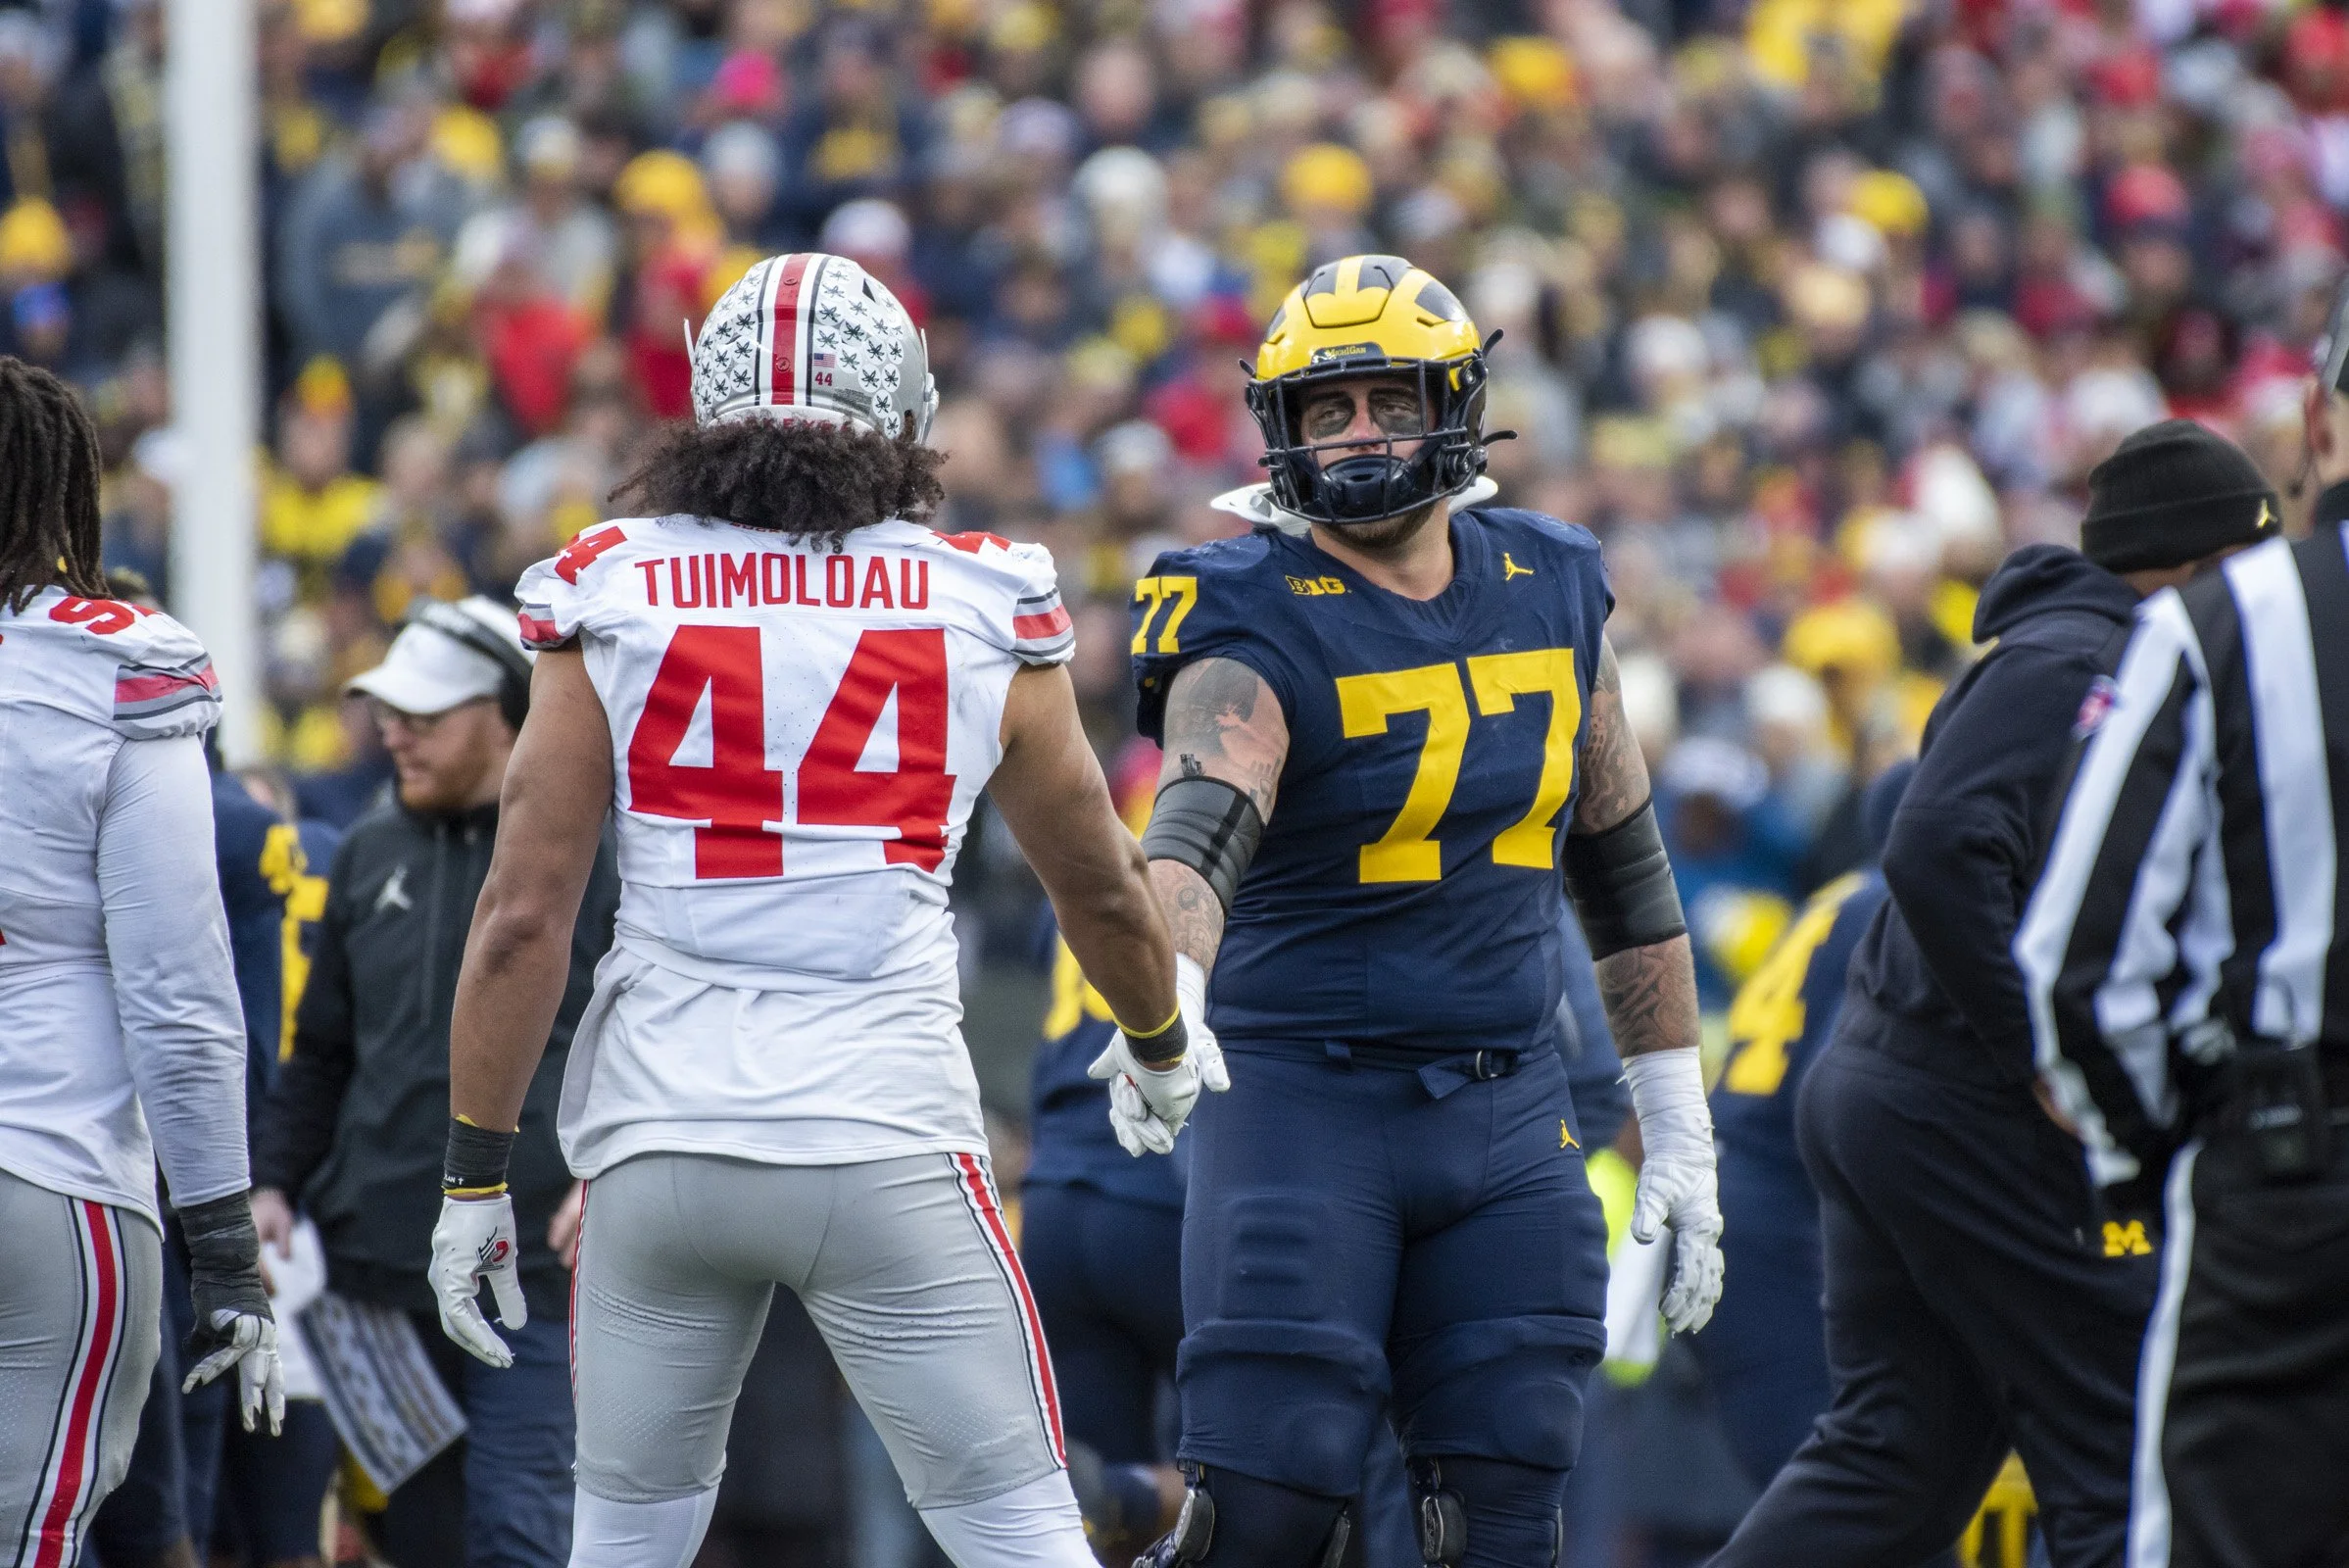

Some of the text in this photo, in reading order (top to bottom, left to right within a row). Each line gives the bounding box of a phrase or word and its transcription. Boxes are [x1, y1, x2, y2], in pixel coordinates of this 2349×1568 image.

[815, 371, 833, 386] 44
[635, 552, 928, 610] TUIMOLOAU
[1131, 576, 1197, 656] 77
[627, 624, 956, 874] 44
[1336, 648, 1581, 883] 77
[2102, 1219, 2152, 1257] M
